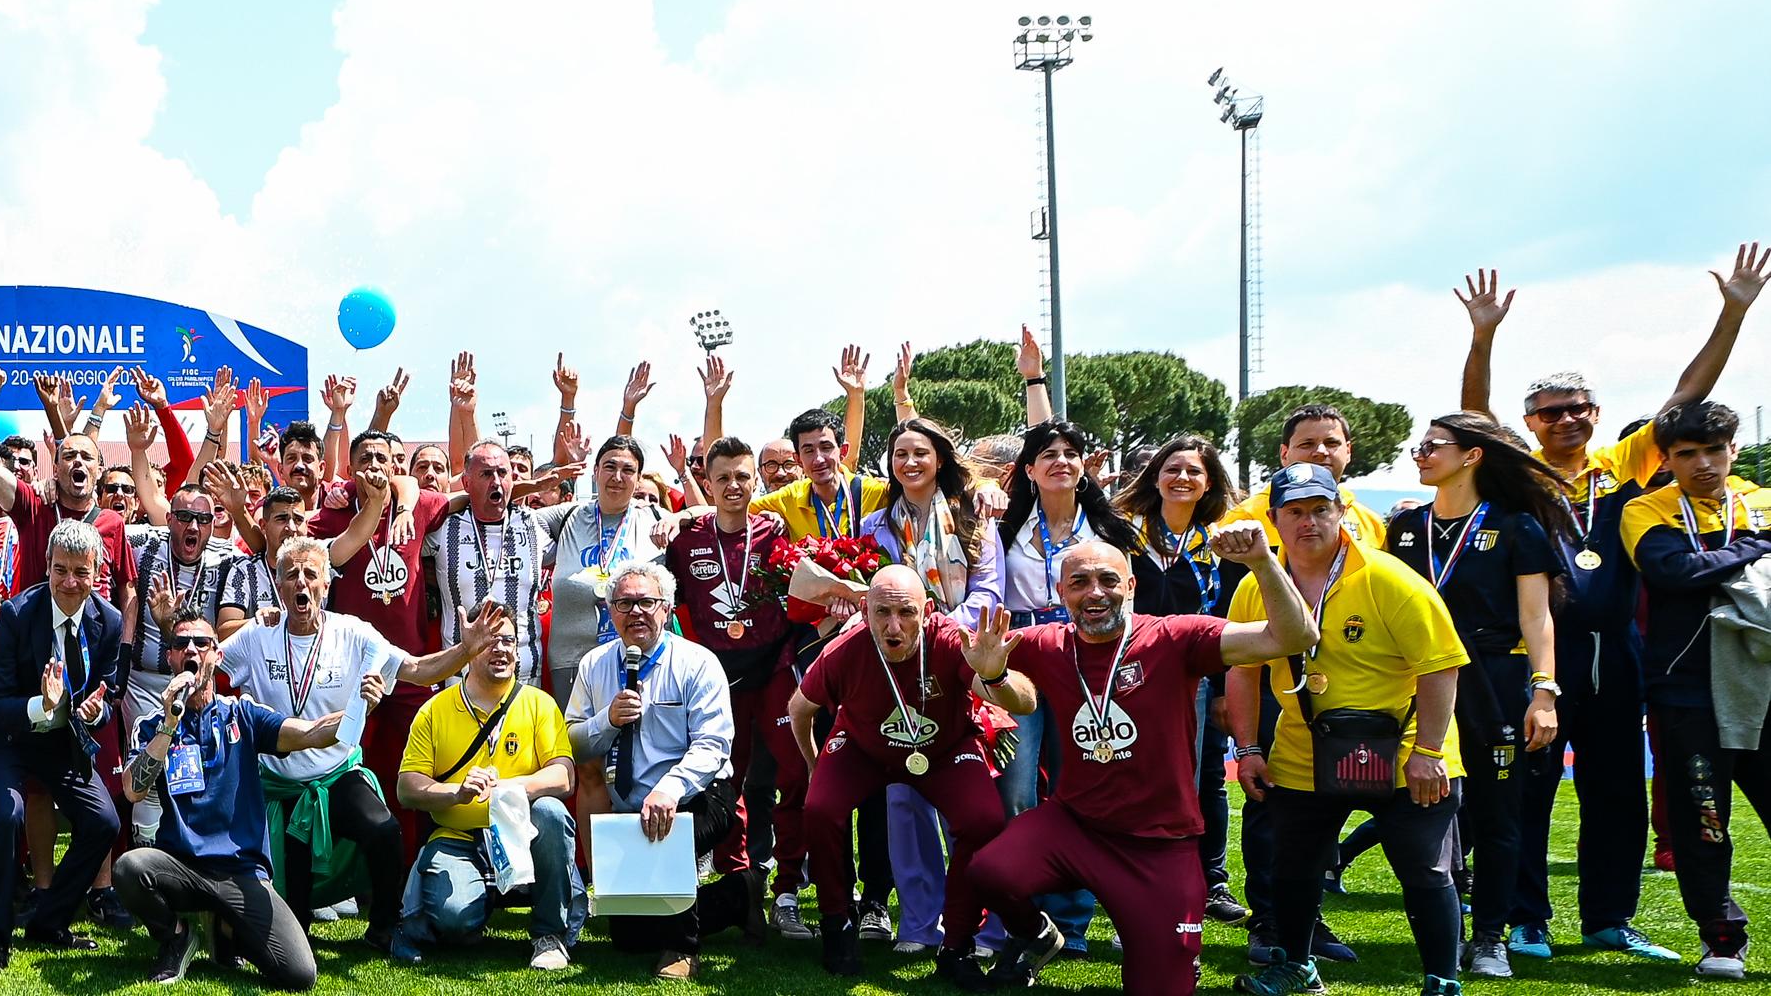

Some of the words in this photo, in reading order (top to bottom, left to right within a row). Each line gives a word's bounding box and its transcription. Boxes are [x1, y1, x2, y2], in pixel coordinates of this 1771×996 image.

[54, 369, 108, 385] MAGGIO
[181, 368, 199, 376] FIGC
[465, 550, 524, 575] Jeep
[371, 587, 406, 600] pieonte
[714, 619, 753, 629] SUKI
[265, 658, 289, 673] TERZ
[1074, 717, 1134, 743] aido
[1082, 749, 1133, 761] piente
